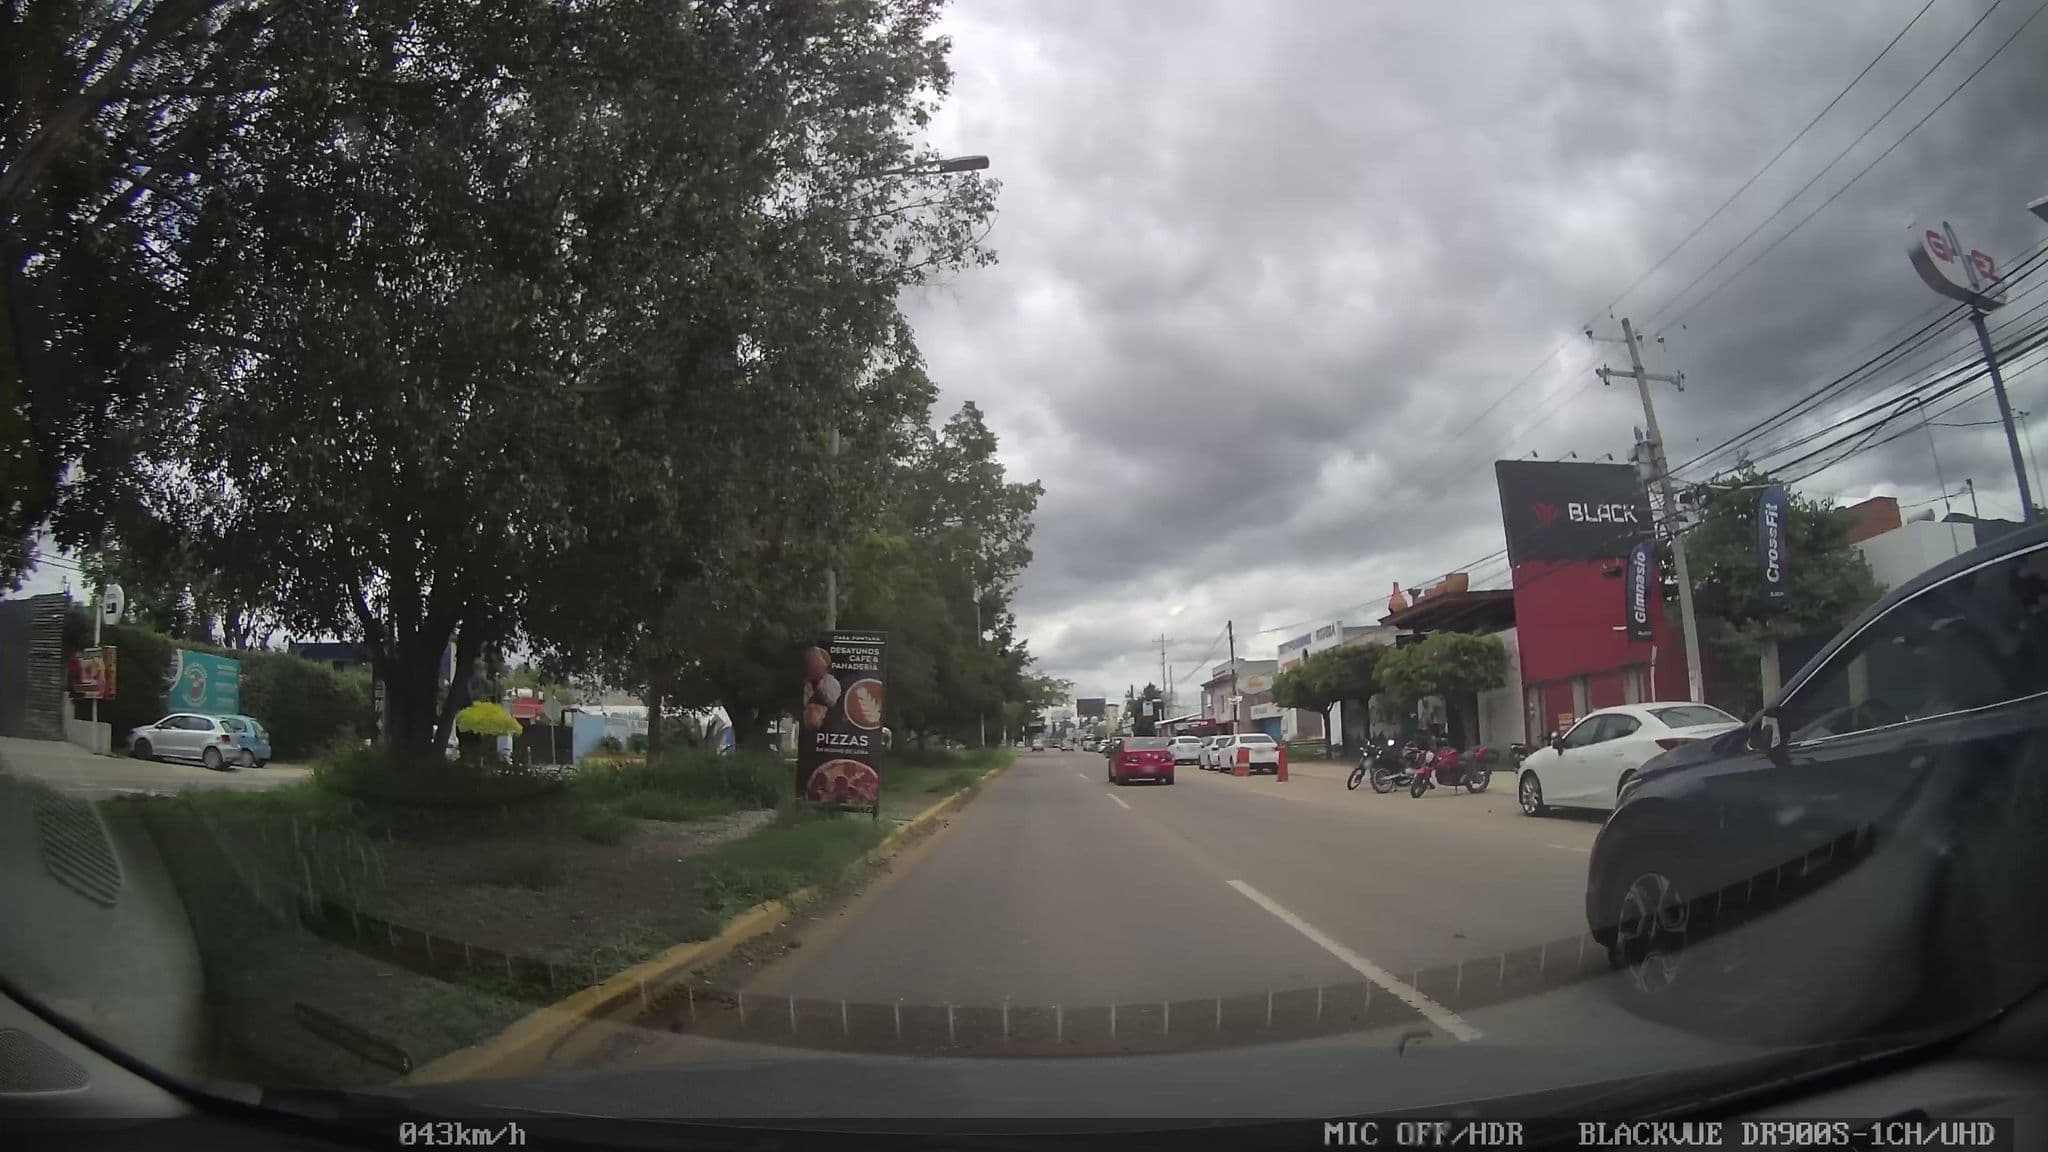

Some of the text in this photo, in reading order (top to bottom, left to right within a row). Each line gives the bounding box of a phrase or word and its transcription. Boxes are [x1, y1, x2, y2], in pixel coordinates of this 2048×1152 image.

[1568, 503, 1638, 523] BLACK
[1765, 502, 1779, 583] CrossFit
[1634, 551, 1647, 624] Gimnasio
[830, 646, 880, 655] DESAYUNOS
[816, 732, 869, 746] PIZZAS
